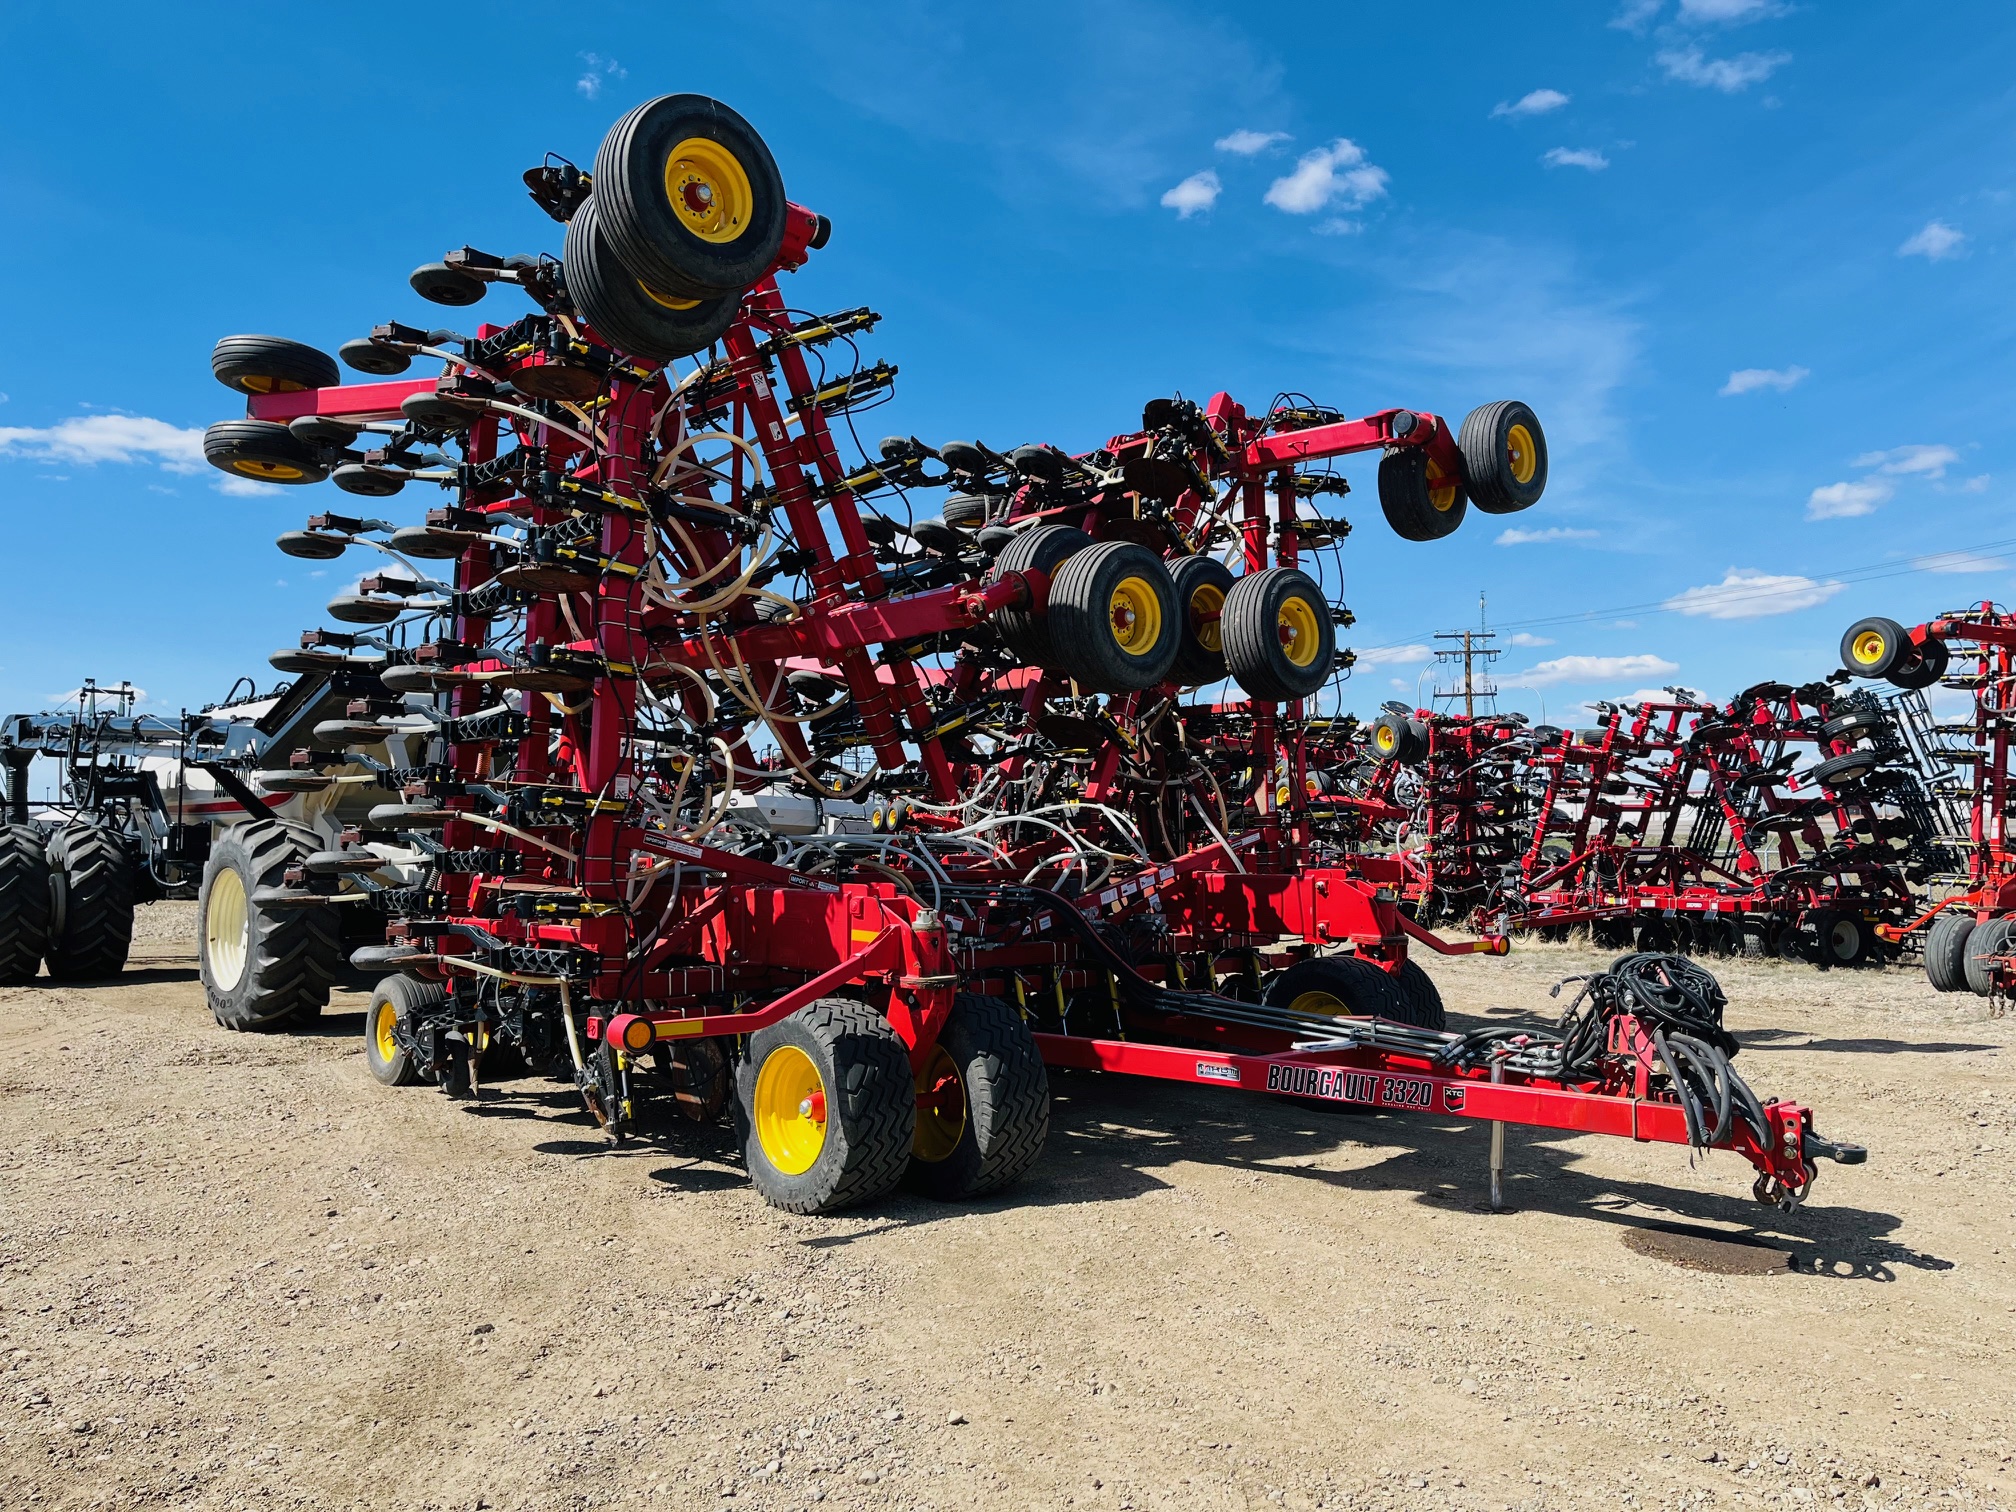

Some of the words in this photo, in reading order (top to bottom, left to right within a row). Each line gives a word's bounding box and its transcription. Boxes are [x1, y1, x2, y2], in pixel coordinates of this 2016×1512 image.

[1266, 1064, 1379, 1103] BOURGAULT
[1382, 1077, 1433, 1107] 3320
[1446, 1089, 1463, 1097] XTC
